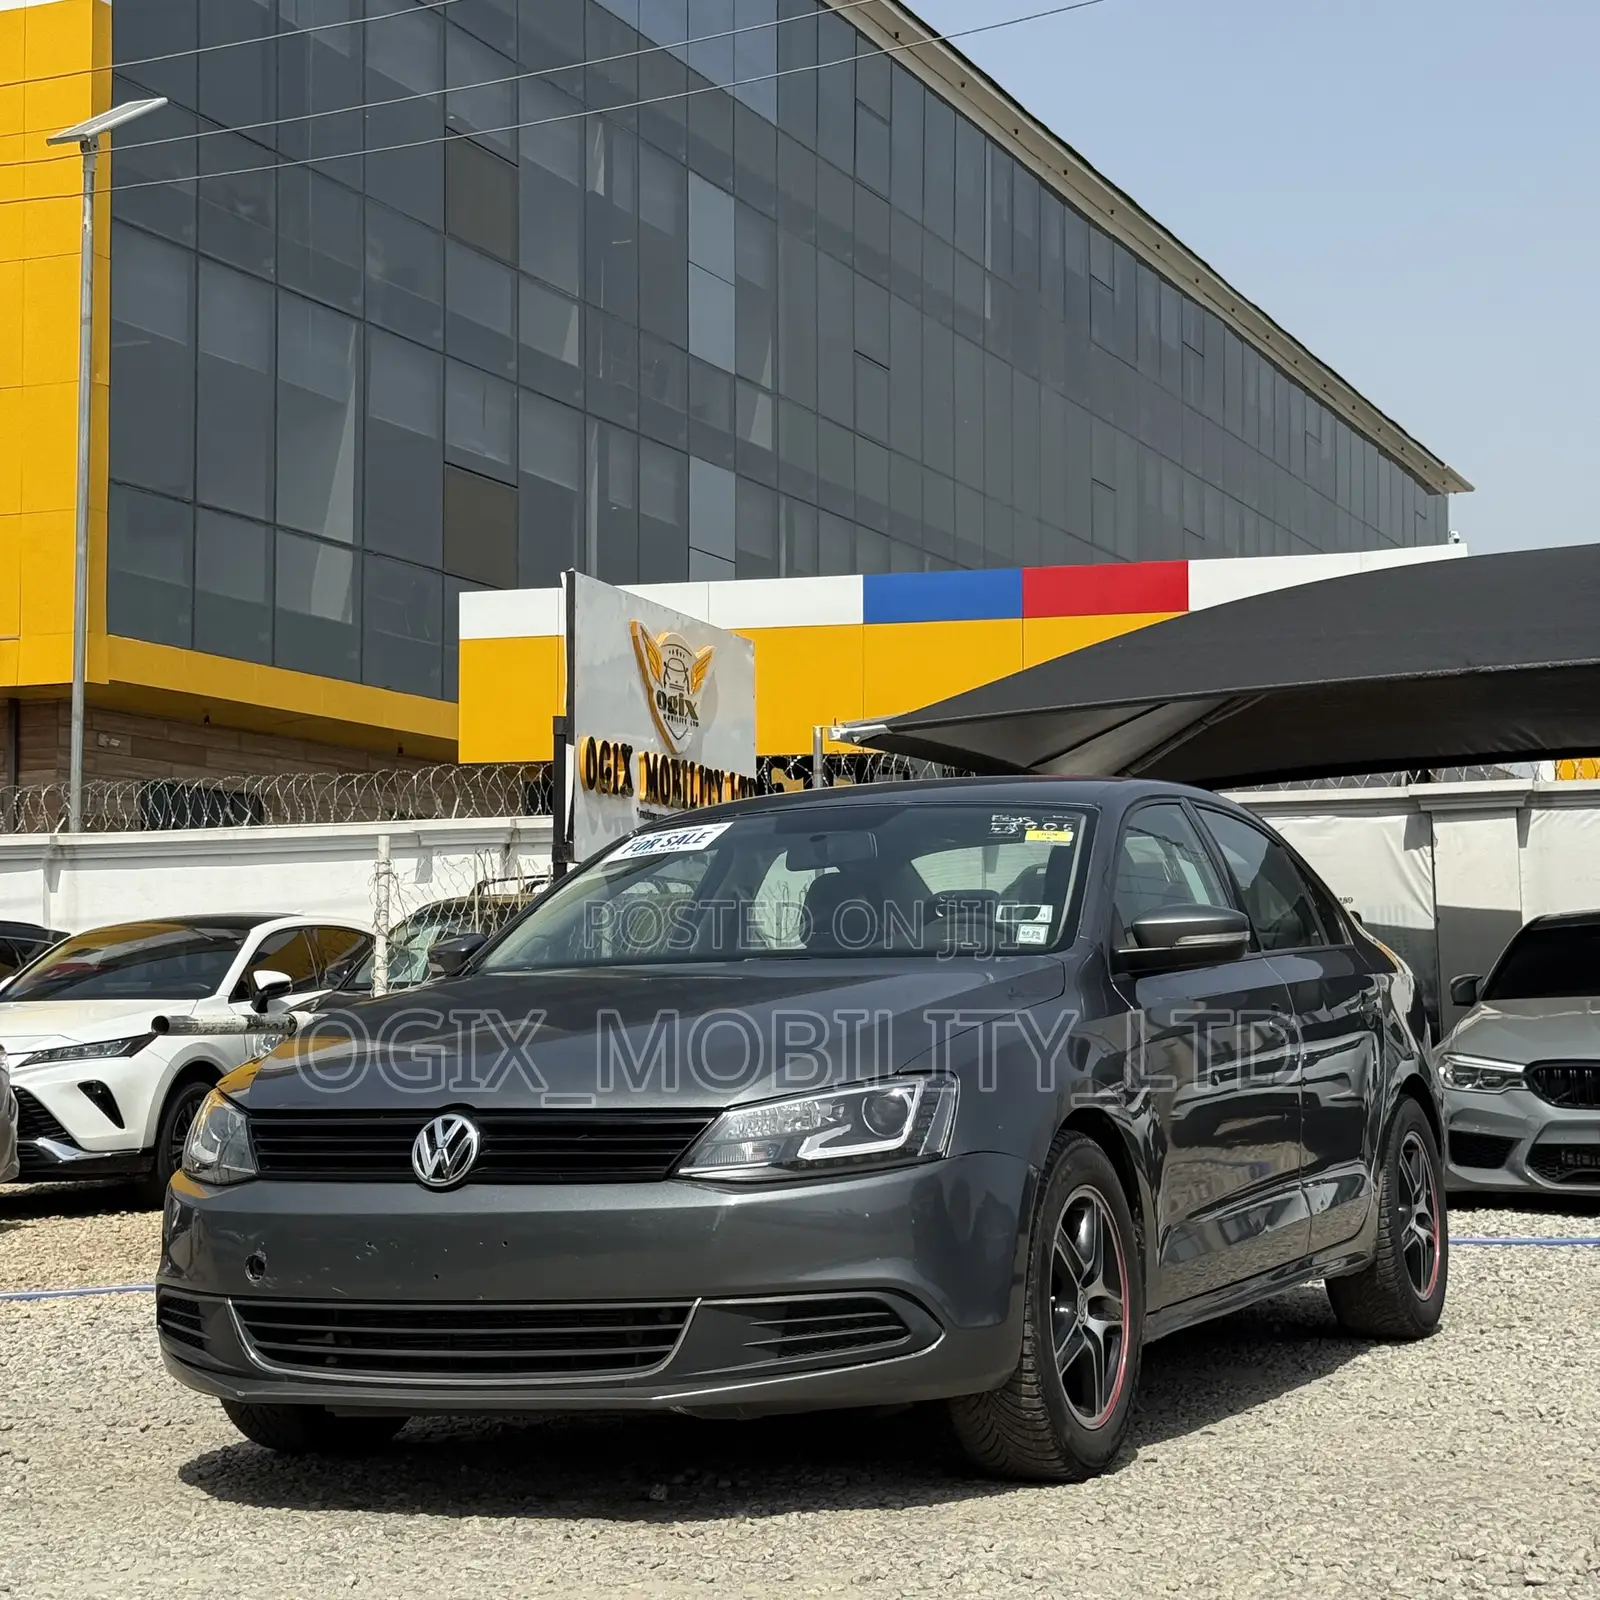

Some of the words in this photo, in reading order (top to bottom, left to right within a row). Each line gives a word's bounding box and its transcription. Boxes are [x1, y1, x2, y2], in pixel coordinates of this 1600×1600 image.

[580, 736, 634, 798] OGIX
[638, 751, 724, 809] MOBILITY
[622, 837, 661, 854] FOR
[660, 831, 713, 847] SALE
